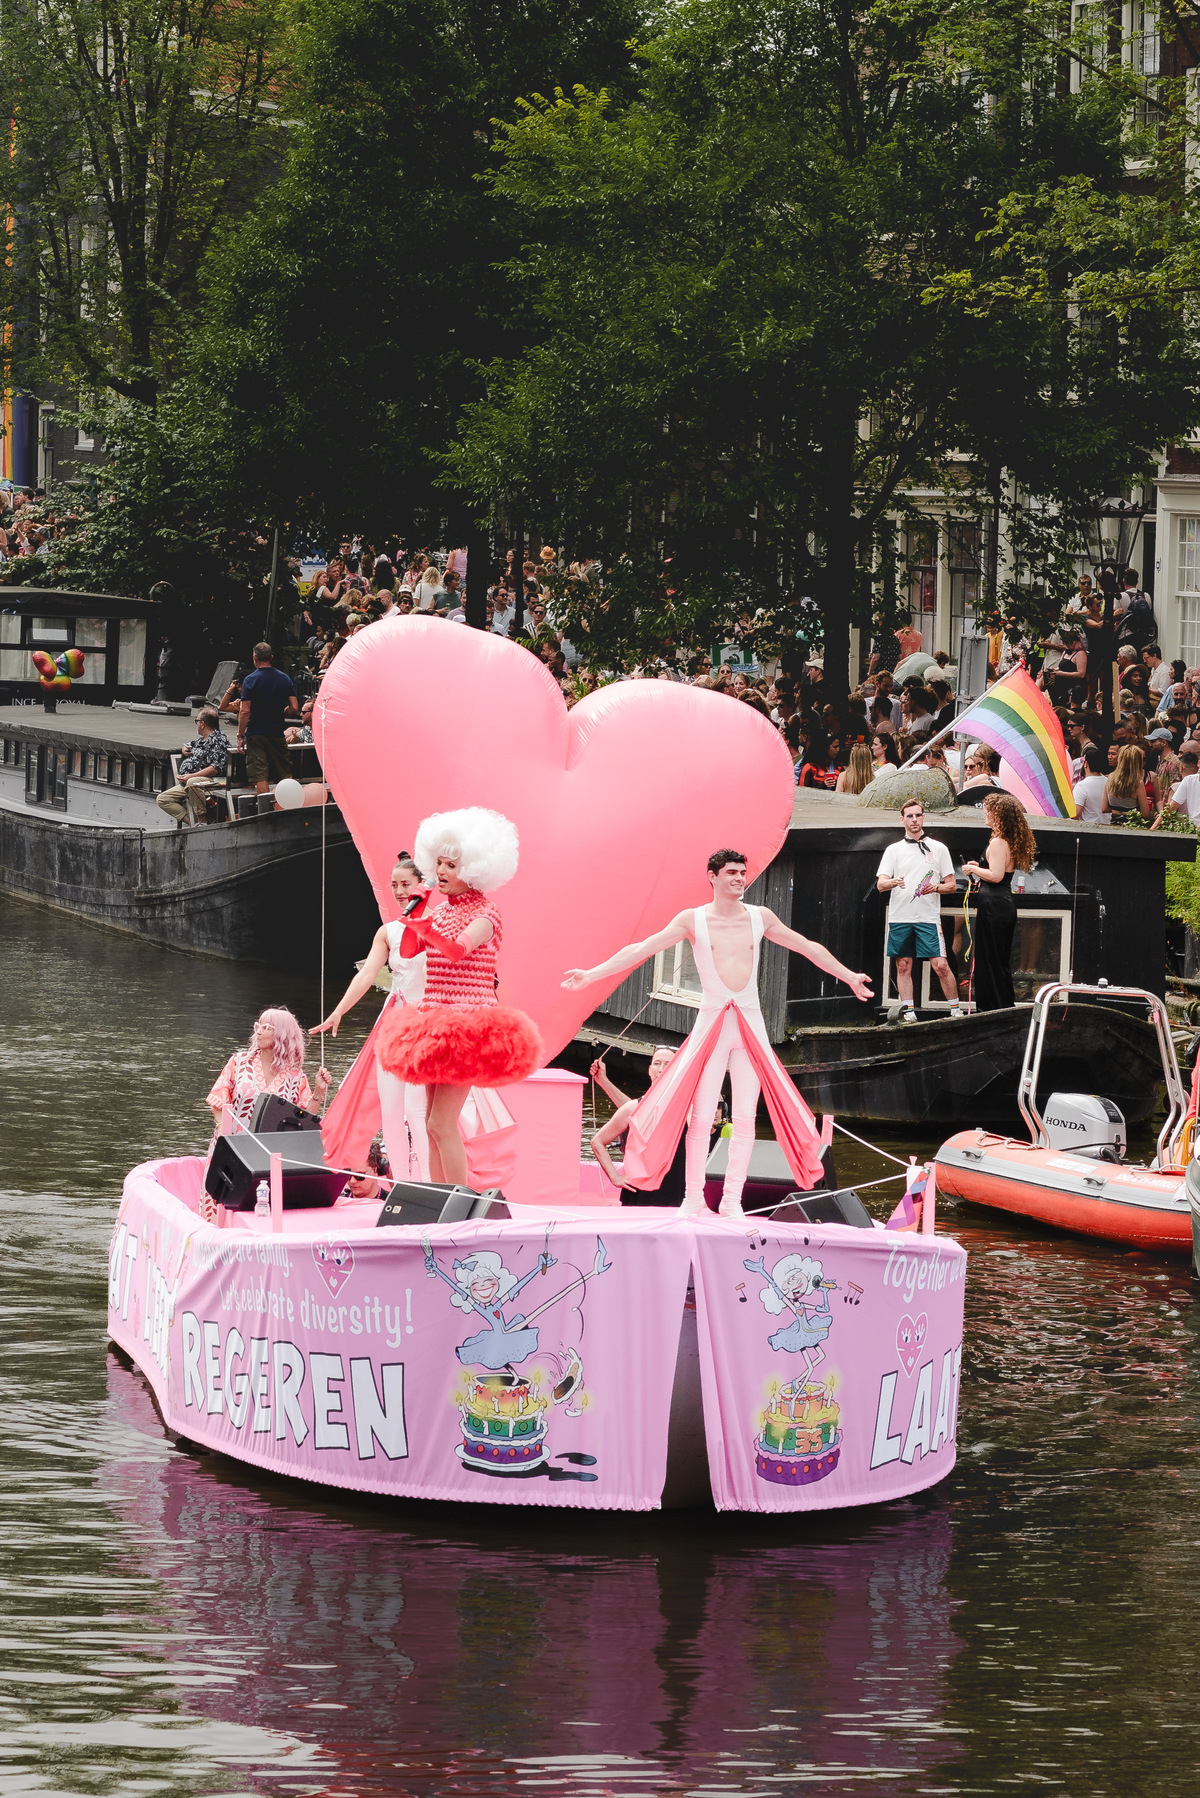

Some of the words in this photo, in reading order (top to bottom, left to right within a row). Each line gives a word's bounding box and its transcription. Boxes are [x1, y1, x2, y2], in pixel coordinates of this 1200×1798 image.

[1045, 1116, 1087, 1132] HONDA
[235, 1241, 253, 1264] are
[254, 1241, 293, 1278] family.
[883, 1239, 950, 1303] Together
[241, 1274, 295, 1323] celebrate
[300, 1288, 414, 1348] diversity!
[182, 1310, 409, 1461] REGEREN
[795, 1428, 822, 1454] 35
